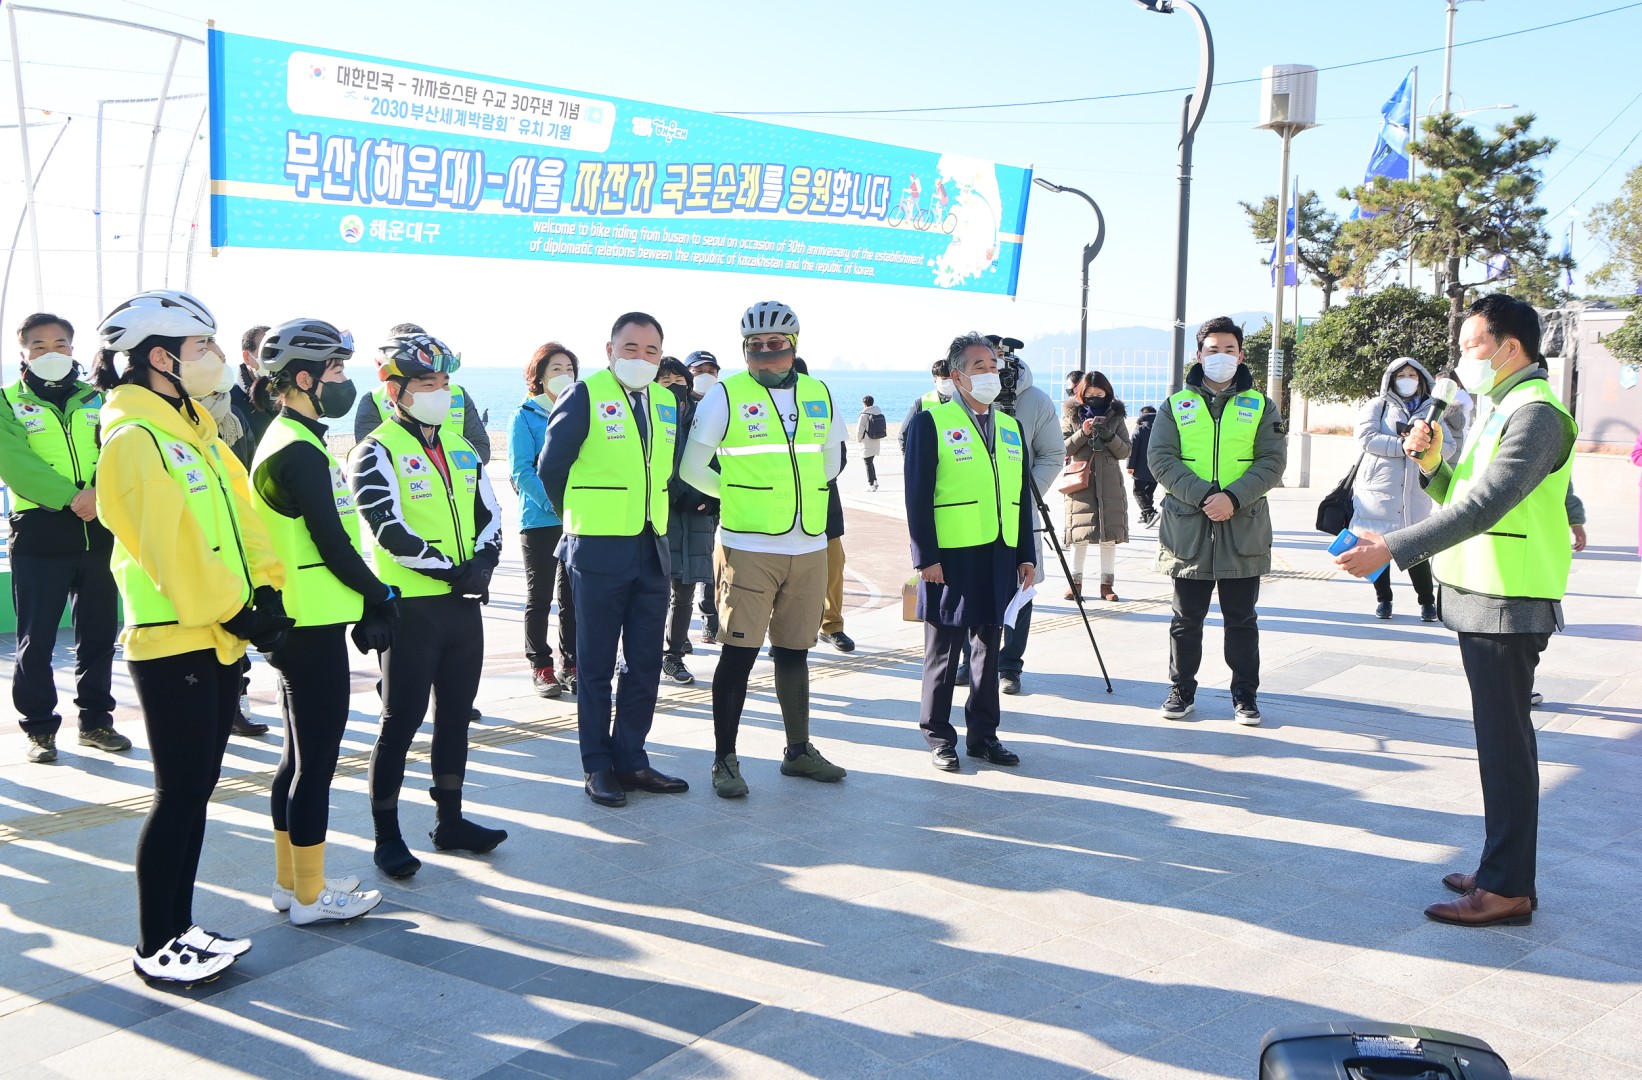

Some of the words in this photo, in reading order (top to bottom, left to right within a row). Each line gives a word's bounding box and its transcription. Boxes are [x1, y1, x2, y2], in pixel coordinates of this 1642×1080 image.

[337, 65, 394, 92] 대한민국
[412, 77, 478, 105] 카자흐스탄
[482, 89, 507, 109] 수교
[511, 94, 553, 116] 30주년
[558, 100, 580, 120] 기념
[518, 118, 544, 137] 유치
[547, 123, 572, 141] 기원
[571, 160, 657, 215] 자전거
[661, 163, 786, 214] 국토순례를
[786, 166, 891, 220] 응원합니다
[369, 219, 441, 244] 해운대구
[533, 219, 576, 236] welcome
[578, 222, 589, 237] to
[590, 221, 611, 239] bike
[612, 223, 638, 244] riding
[640, 225, 661, 242] from
[663, 227, 690, 245] busan
[691, 231, 701, 246] to
[703, 233, 727, 248] seoul
[727, 237, 738, 250] on
[740, 237, 776, 252] occasion
[776, 239, 787, 253] of
[786, 239, 806, 254] 30th
[807, 243, 850, 261] anniversary
[852, 246, 862, 260] of
[862, 246, 873, 261] the
[875, 249, 925, 266] establishment
[529, 237, 543, 253] of
[543, 237, 594, 257] diplomatic
[595, 240, 636, 259] relations
[637, 243, 673, 262] beween
[675, 247, 690, 263] the
[726, 252, 738, 266] of
[738, 252, 784, 270] kazakhstan
[785, 256, 801, 271] and
[801, 258, 814, 272] the
[843, 262, 854, 274] of
[606, 425, 618, 433] DK
[1181, 413, 1190, 421] DK
[410, 482, 424, 490] DK
[337, 497, 349, 506] DK
